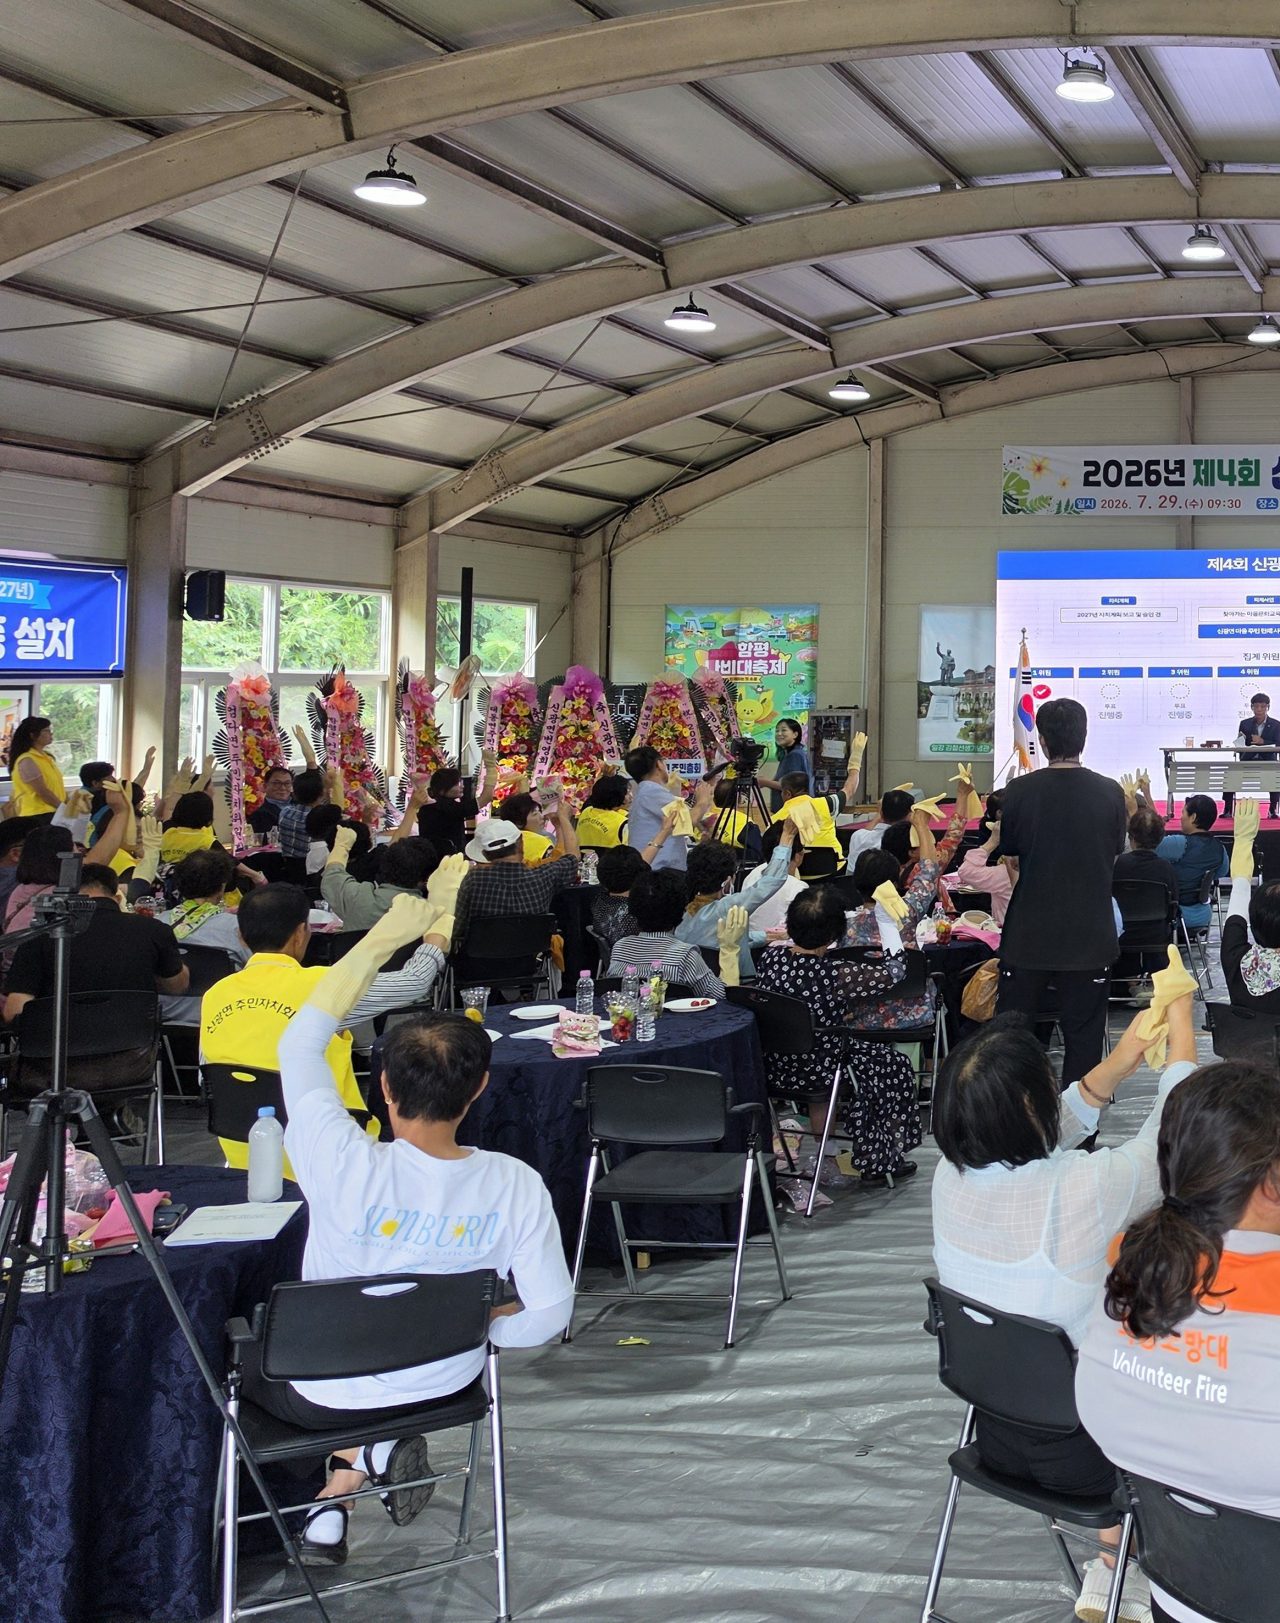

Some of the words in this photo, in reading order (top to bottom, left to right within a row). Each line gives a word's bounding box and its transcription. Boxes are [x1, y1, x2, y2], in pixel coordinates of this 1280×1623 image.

[1082, 458, 1186, 488] 2026년
[1193, 457, 1261, 487] 제4회
[1077, 498, 1095, 509] 일시
[1101, 498, 1132, 509] 2026.
[1138, 494, 1151, 509] 7.
[1207, 498, 1241, 509] 09:30
[1257, 498, 1277, 509] 장소
[1207, 557, 1248, 572] 제4회
[14, 616, 75, 660] 설치
[737, 642, 770, 658] 함평
[1242, 652, 1260, 661] 집계
[1098, 711, 1123, 720] 진행중
[1168, 711, 1193, 720] 진행중
[206, 1004, 234, 1034] 신광면
[235, 997, 297, 1020] 주민자치회
[1112, 1348, 1192, 1396] Volunteer
[1196, 1373, 1228, 1404] Fire
